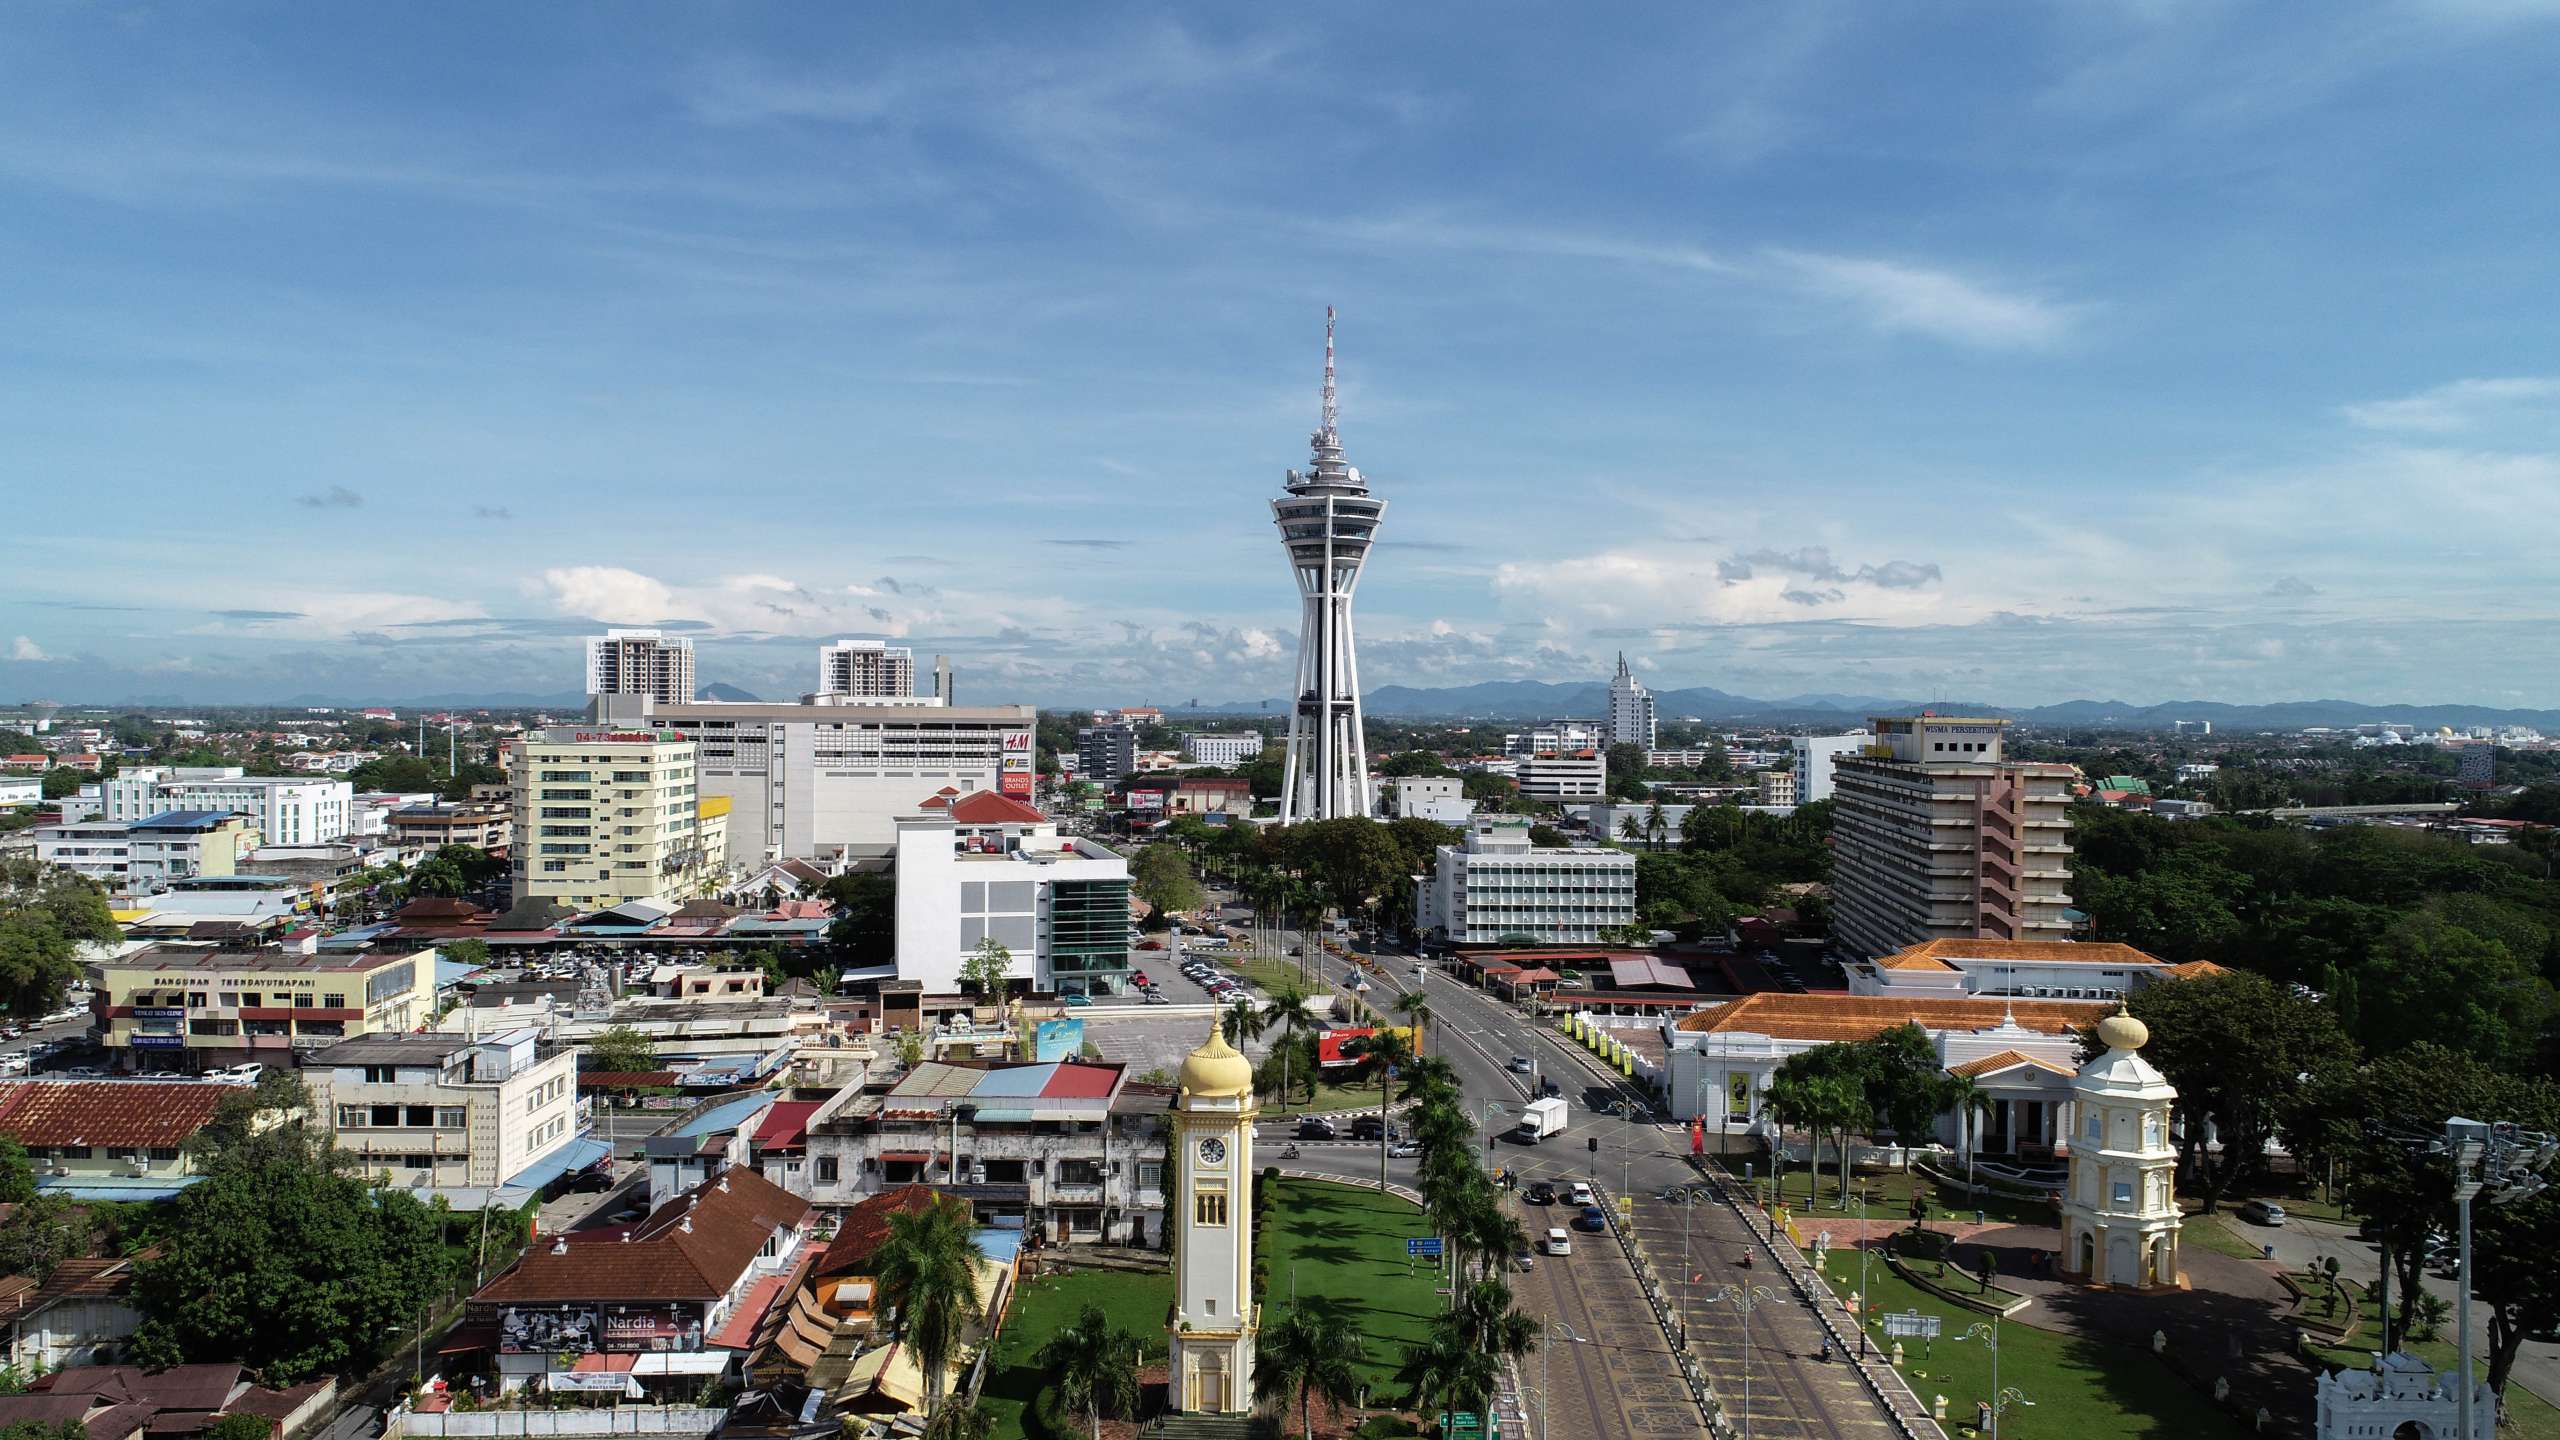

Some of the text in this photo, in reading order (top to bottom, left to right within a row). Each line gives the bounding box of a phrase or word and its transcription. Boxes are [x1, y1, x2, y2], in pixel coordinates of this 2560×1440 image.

[1951, 726, 1999, 734] PERSEKUTUAN
[1005, 734, 1029, 749] H&M
[154, 978, 210, 986] BANGUNAN
[607, 1315, 656, 1329] Nardia
